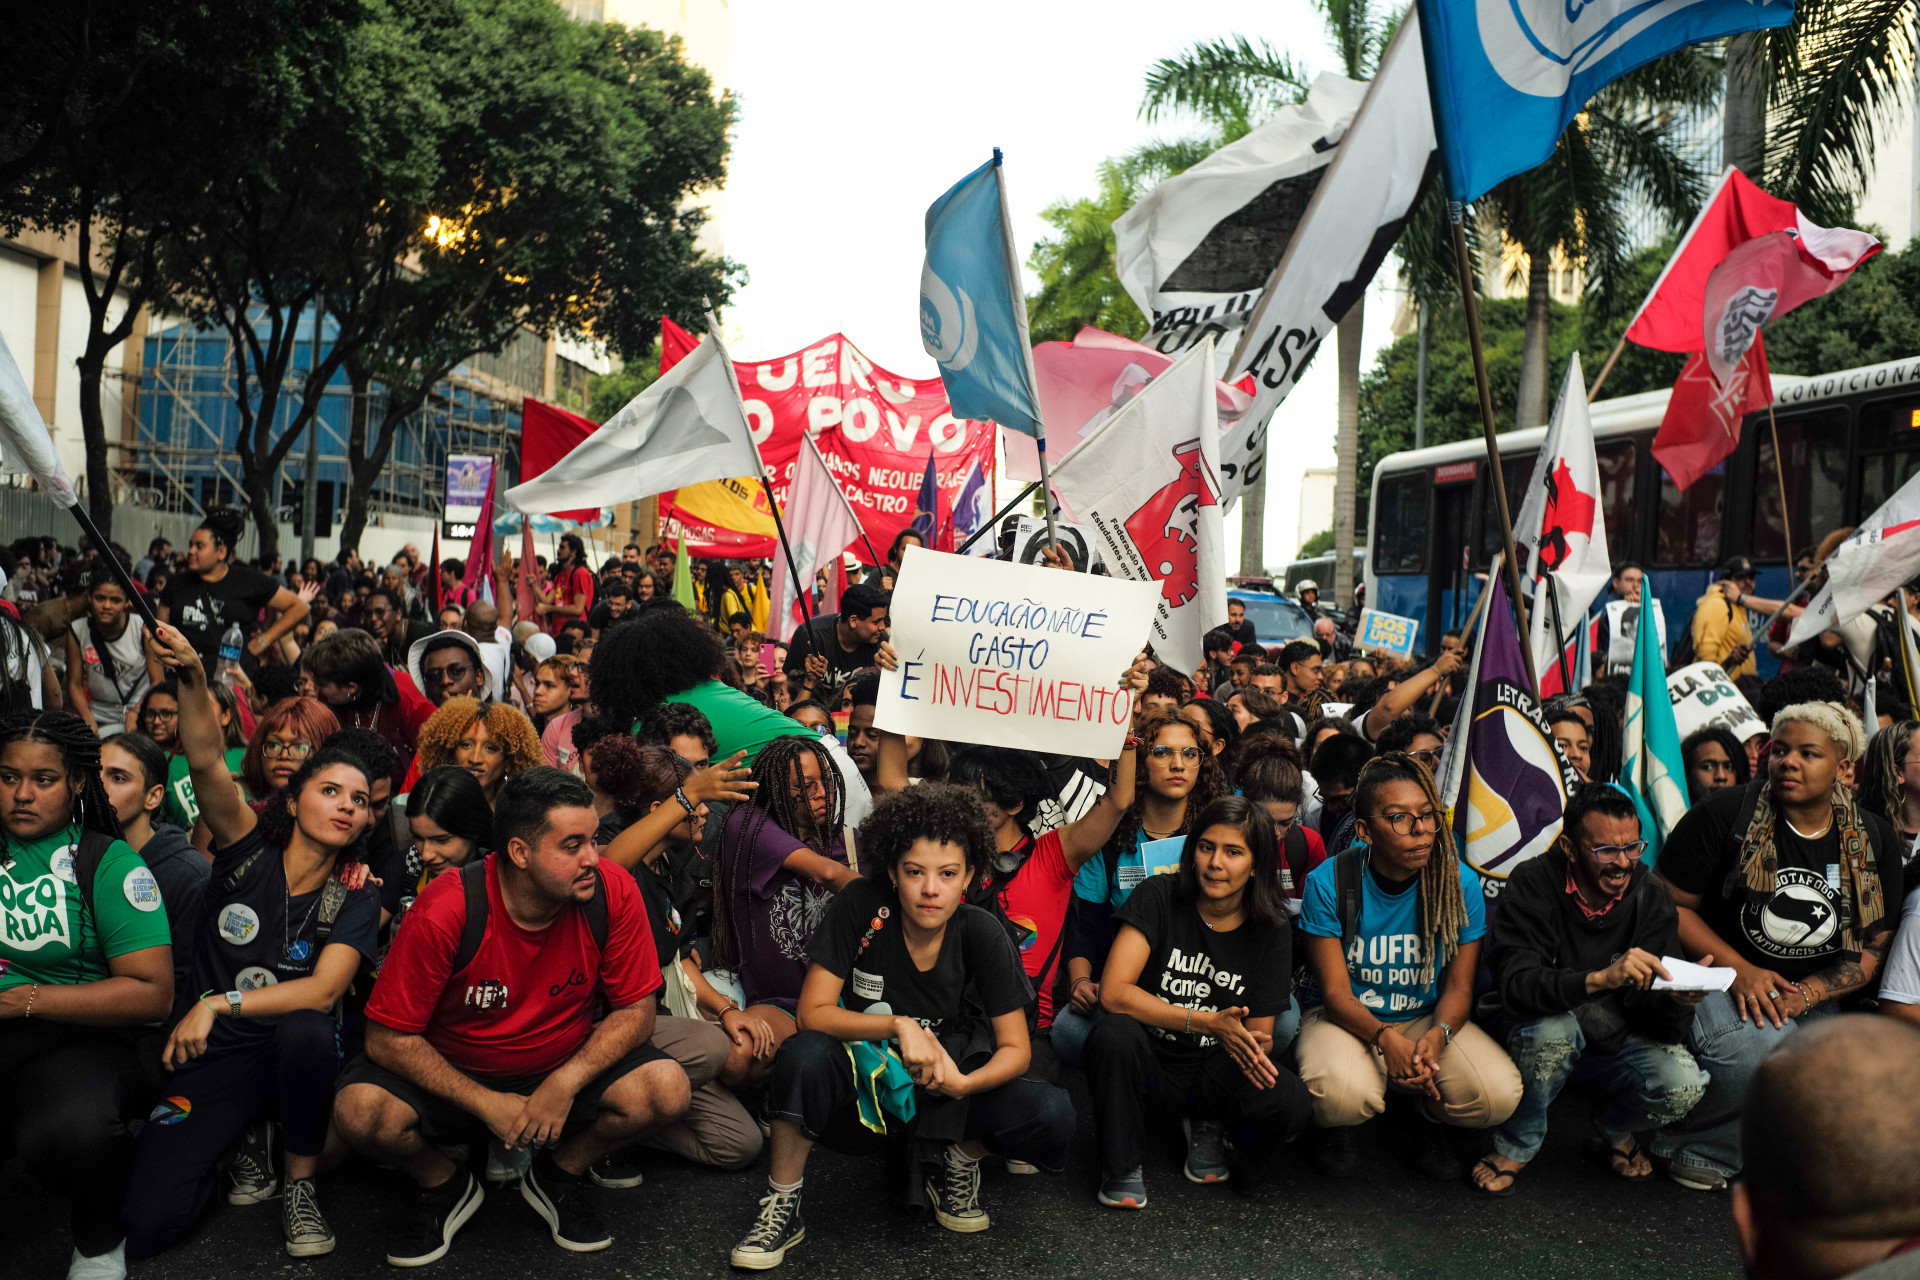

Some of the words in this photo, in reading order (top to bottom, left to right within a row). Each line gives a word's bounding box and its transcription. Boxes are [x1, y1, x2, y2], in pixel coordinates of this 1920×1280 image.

[807, 395, 966, 452] POVO
[868, 466, 967, 491] NEOLIBRAIS
[845, 483, 908, 513] CASTRO
[1110, 517, 1139, 567] Federação
[1090, 510, 1123, 563] Estudantes
[1120, 561, 1131, 577] em
[1154, 617, 1168, 641] nico
[1047, 606, 1085, 635] NÃO
[1081, 608, 1108, 639] É
[1370, 628, 1406, 647] UFRJ
[1372, 616, 1407, 635] SOS
[969, 632, 1049, 671] GASTO
[900, 648, 925, 700] É
[931, 662, 1131, 726] INVESTIMENTO
[1696, 684, 1735, 706] DO
[1497, 683, 1551, 735] LETRAS
[5, 909, 65, 942] RUA
[1347, 935, 1365, 964] A
[1370, 934, 1430, 965] UFR
[1750, 928, 1835, 956] ANTIFASCISTA
[1161, 971, 1212, 998] tome
[1167, 948, 1246, 996] Mulher,
[1361, 968, 1383, 984] DO
